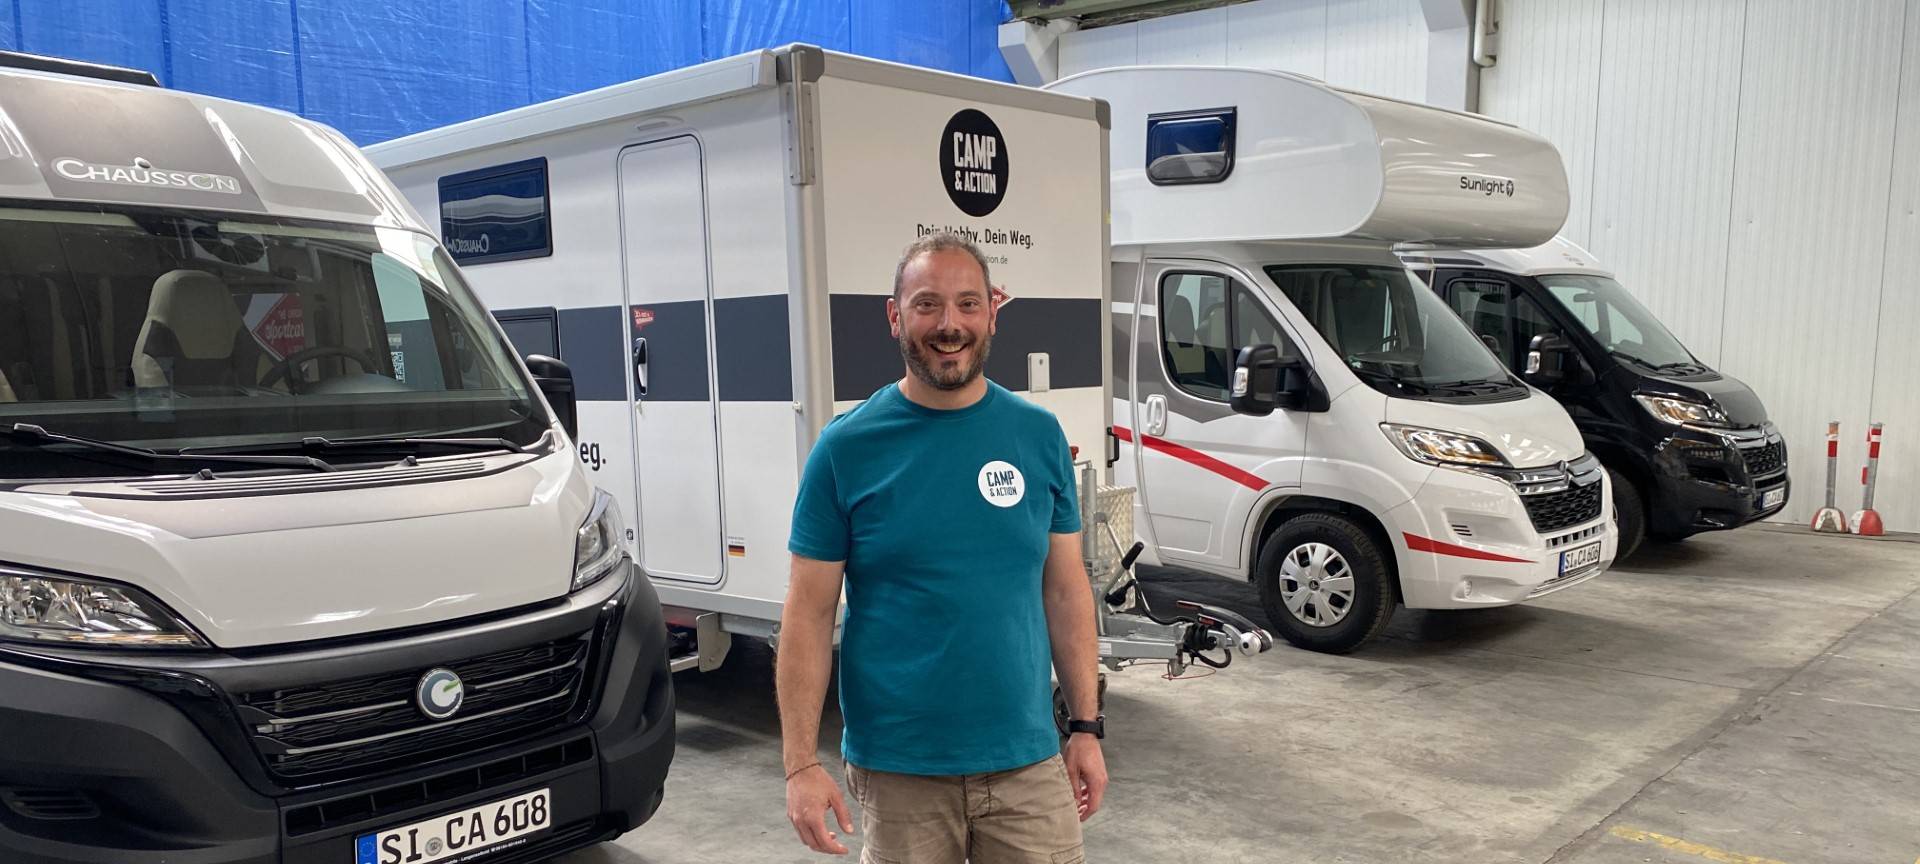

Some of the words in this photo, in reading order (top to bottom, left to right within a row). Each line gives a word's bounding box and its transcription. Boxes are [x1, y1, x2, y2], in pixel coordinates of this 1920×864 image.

[953, 131, 996, 170] CAMP
[954, 170, 963, 191] &
[964, 171, 997, 194] ACTION
[1460, 176, 1505, 196] Sunlight
[985, 228, 1007, 245] Dein
[1010, 230, 1034, 249] Weg.
[986, 470, 1015, 487] CAMP
[990, 487, 996, 497] &
[996, 486, 1018, 497] ACTION
[1565, 552, 1574, 569] SI
[1578, 549, 1587, 566] CA
[381, 828, 423, 864] SI
[446, 812, 486, 849] CA
[493, 794, 547, 836] 608
